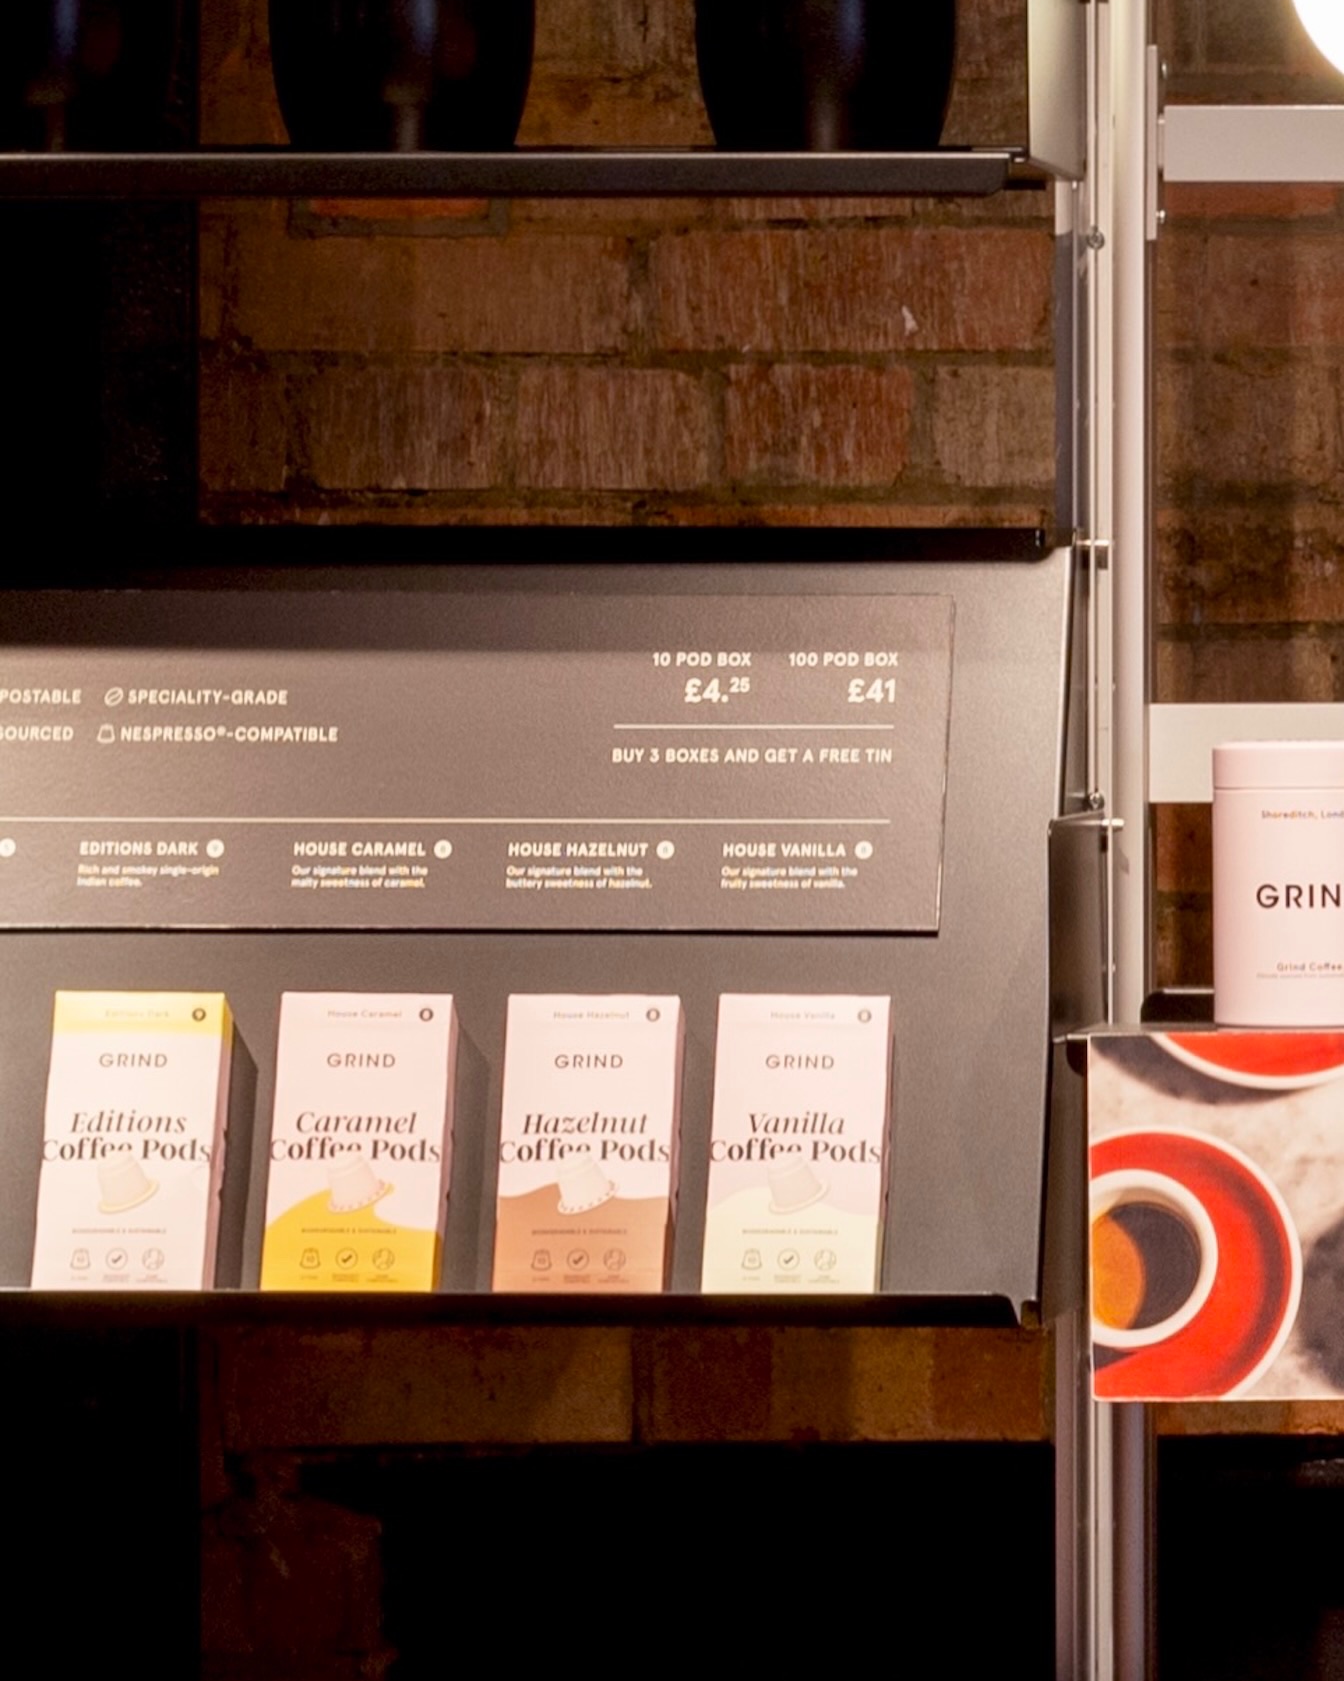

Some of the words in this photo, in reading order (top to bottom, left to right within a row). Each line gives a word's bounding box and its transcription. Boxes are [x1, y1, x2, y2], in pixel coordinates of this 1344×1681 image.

[652, 651, 671, 667] 10
[675, 651, 713, 667] POD
[717, 651, 752, 667] BOX
[788, 651, 819, 667] 100
[822, 651, 860, 667] POD
[863, 651, 899, 667] BOX
[127, 688, 288, 705] SPECIALITY-GRADE
[684, 676, 751, 703] £4.25
[847, 677, 896, 704] £41
[612, 747, 645, 763] BUY
[649, 747, 660, 763] 3
[665, 747, 720, 763] BOXES
[723, 747, 760, 764] AND
[764, 747, 799, 763] GET
[802, 748, 814, 763] A
[819, 747, 861, 763] FREE
[865, 748, 893, 763] TIN
[79, 840, 153, 856] EDITIONS
[156, 841, 199, 856] DARK
[293, 841, 348, 857] HOUSE
[351, 841, 426, 857] CARAMEL
[508, 842, 562, 857] HOUSE
[566, 842, 649, 857] HAZELNUT
[722, 842, 777, 858] HOUSE
[780, 842, 847, 858] VANILLA
[98, 1053, 168, 1068] GRIND
[71, 1109, 187, 1133] Editions
[295, 1111, 417, 1134] Caramel
[522, 1111, 647, 1135] Hazelnut
[749, 1111, 844, 1135] Vanilla
[141, 1138, 211, 1162] Pods
